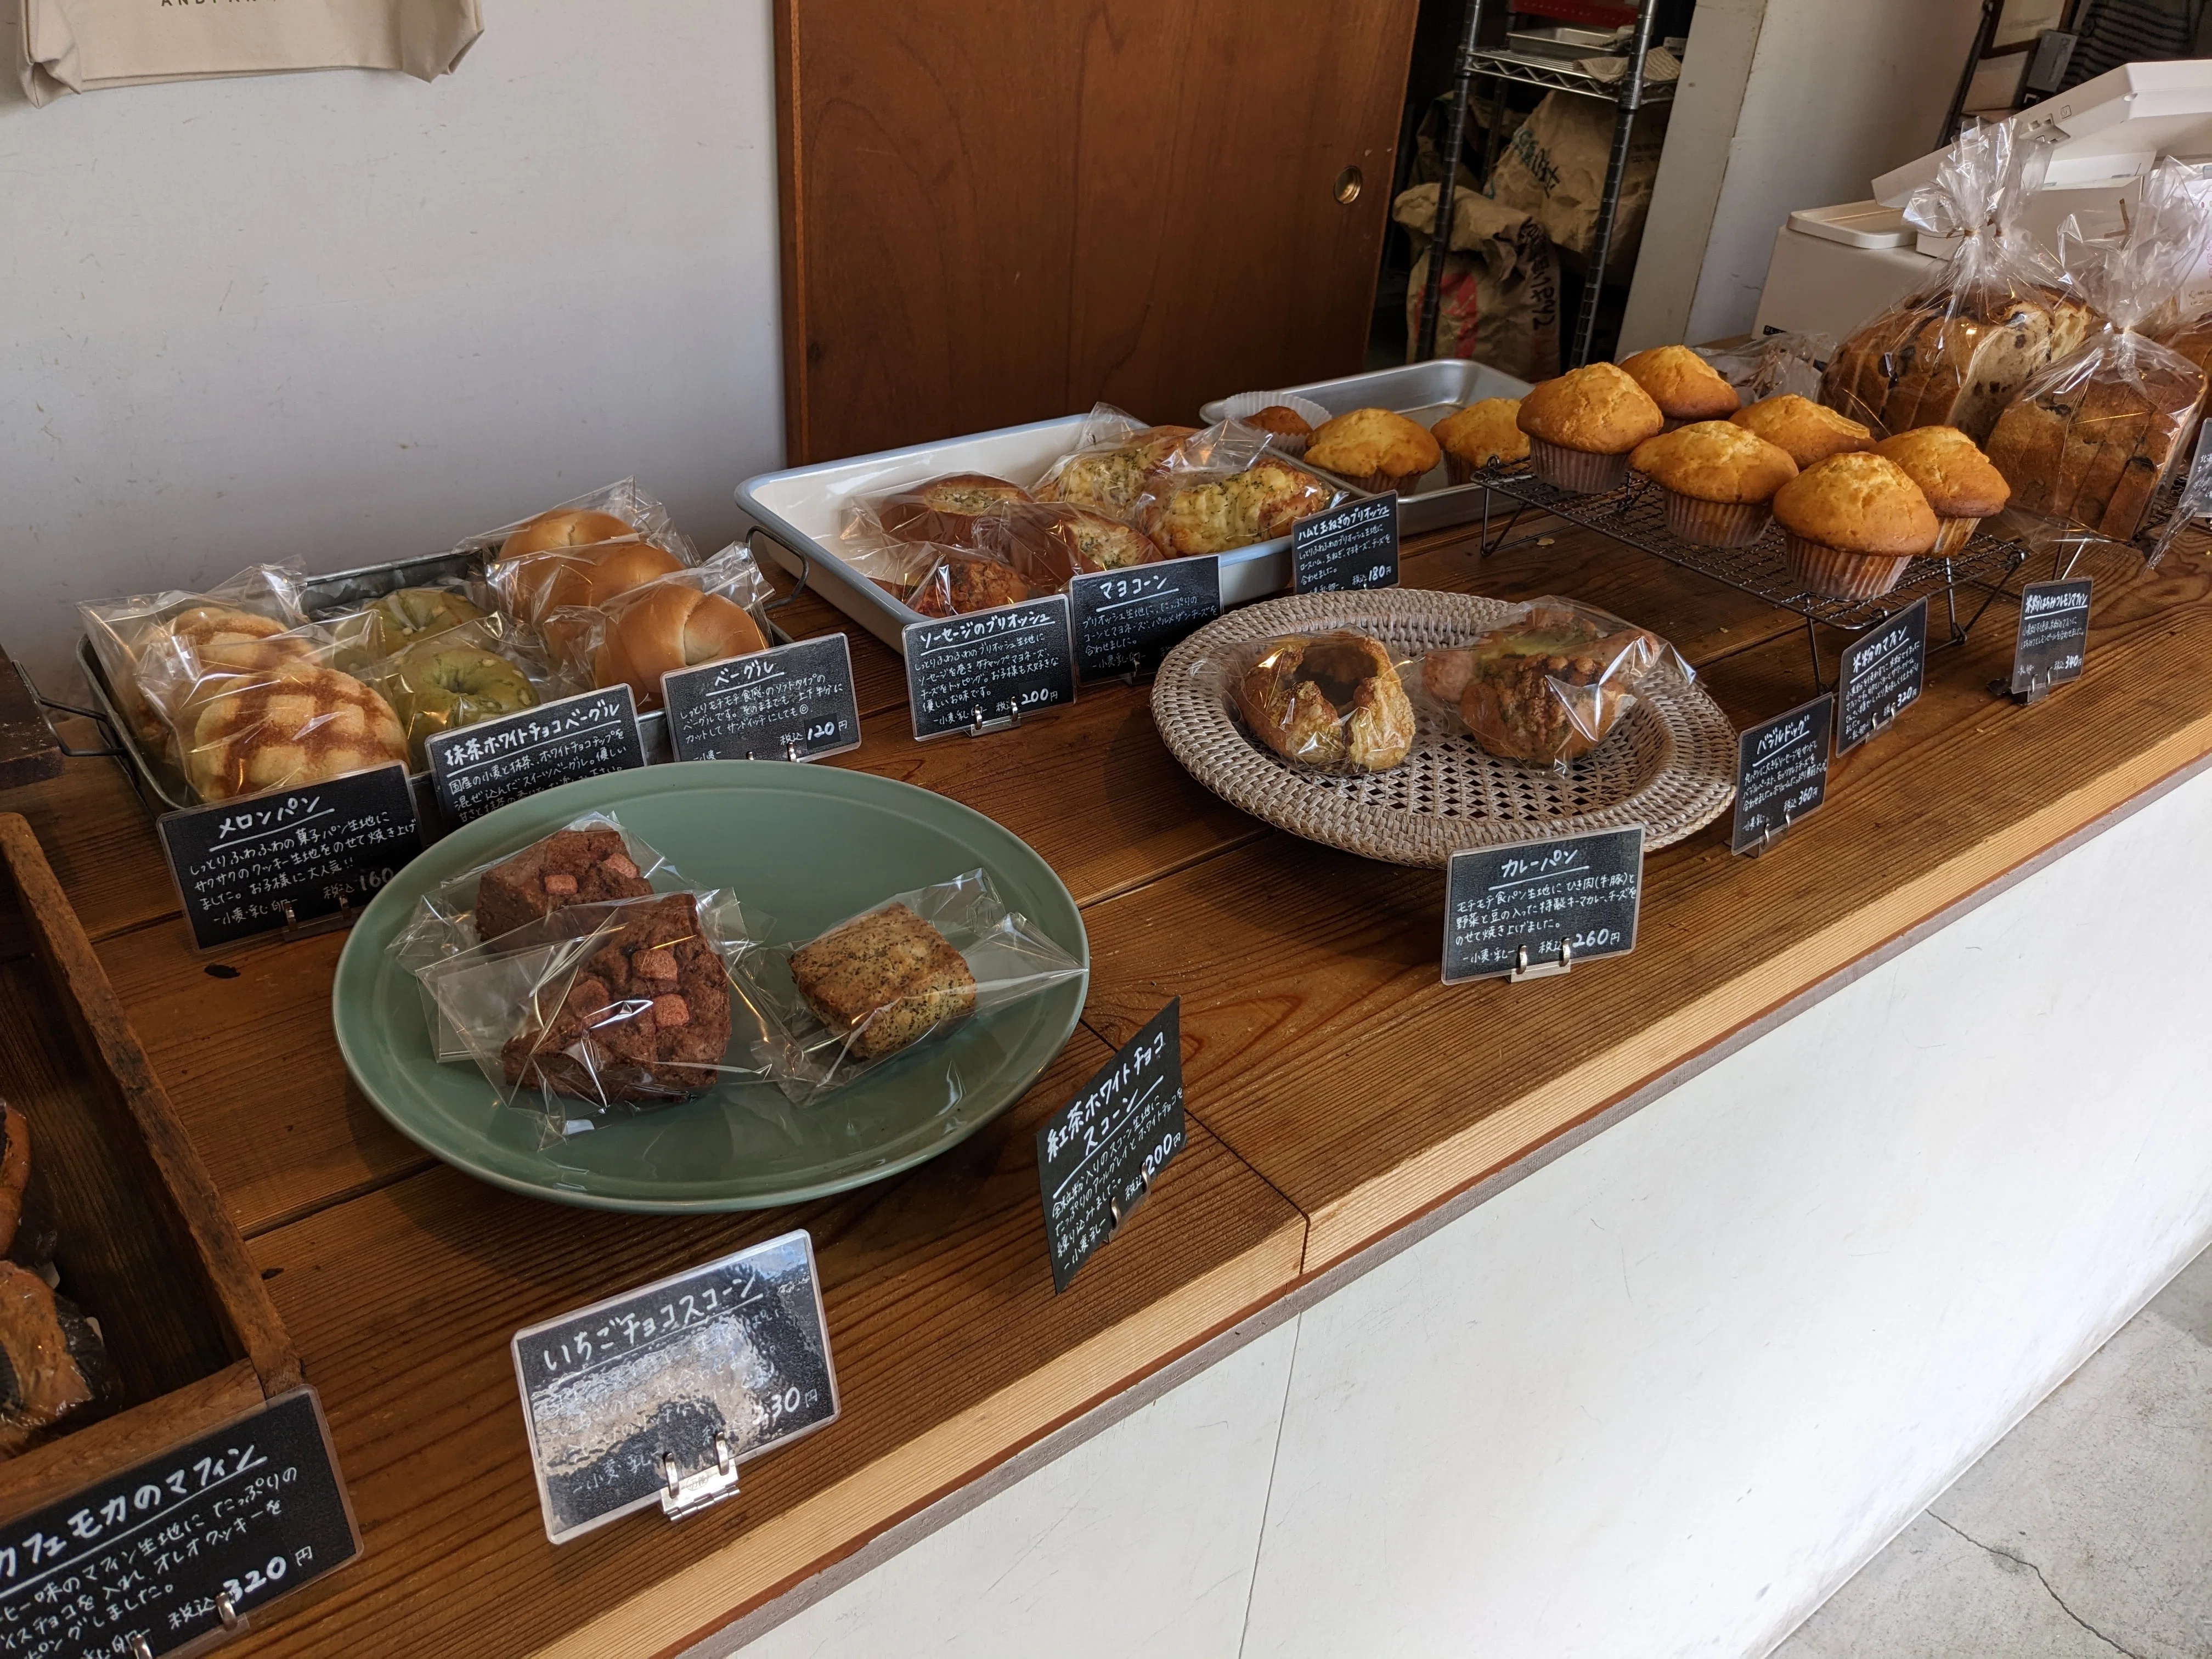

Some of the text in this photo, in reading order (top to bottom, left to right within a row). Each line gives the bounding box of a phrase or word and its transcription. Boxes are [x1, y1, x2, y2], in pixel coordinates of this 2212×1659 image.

[1100, 574, 1167, 600] マヨコーン
[915, 633, 1045, 671] しっとりふわふわのブリオッシュ生地に
[920, 611, 1050, 649] ソーセージのブリオッシュ
[1085, 639, 1137, 656] 合わせました。
[1853, 626, 1907, 674] 米粉のマフィン
[714, 660, 774, 687] ベーグル
[444, 698, 620, 766] 抹茶ホワイトチョコベーグル
[1757, 714, 1810, 755] バジルドッグ
[219, 795, 320, 839] メロンパン
[190, 811, 388, 876] しっとりふわふわの菓子パン生地に
[194, 819, 417, 892] サクサクのクッキー生地をのせて焼き上げ
[1501, 849, 1578, 877] カレーパン
[1455, 919, 1560, 946] のせて焼き上げました。
[1047, 1030, 1165, 1163] 紅茶ホワイトチョコ
[1084, 1088, 1139, 1156] スコーン
[1053, 1095, 1161, 1218] 全粒粉入りのスコーン生地に
[1057, 1177, 1122, 1258] 練り込みました。
[543, 1272, 760, 1372] いちごチョコスコーン
[0, 1444, 255, 1578] カフェモカのマフィン
